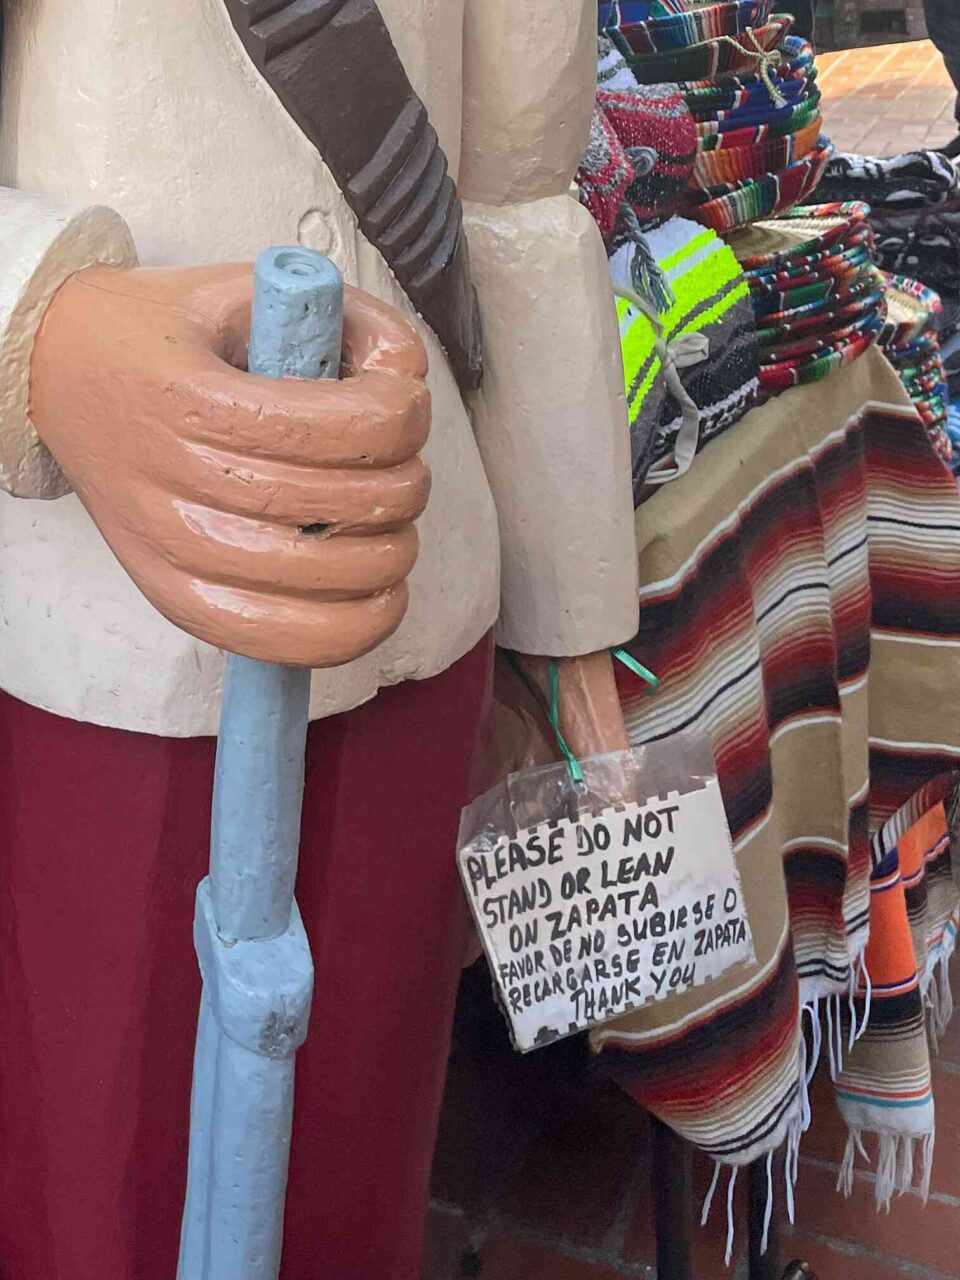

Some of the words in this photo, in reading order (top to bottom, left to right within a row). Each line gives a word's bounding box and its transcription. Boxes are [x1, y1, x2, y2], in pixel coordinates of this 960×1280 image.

[467, 827, 565, 896] PLEASE
[576, 824, 611, 856] DO
[623, 805, 680, 847] NOT
[483, 878, 552, 929] STAND
[561, 866, 592, 900] OR
[601, 846, 675, 889] LEAN
[499, 950, 546, 989] FAVOR
[549, 938, 572, 967] DE
[578, 929, 605, 960] NO
[723, 887, 737, 913] O
[509, 918, 538, 953] ON
[545, 881, 659, 941] ZAPATA
[508, 949, 640, 1015] RECARGARSE
[652, 937, 686, 967] EN
[694, 917, 746, 957] ZAPATA
[570, 975, 641, 1021] THANK
[650, 962, 696, 995] YOU
